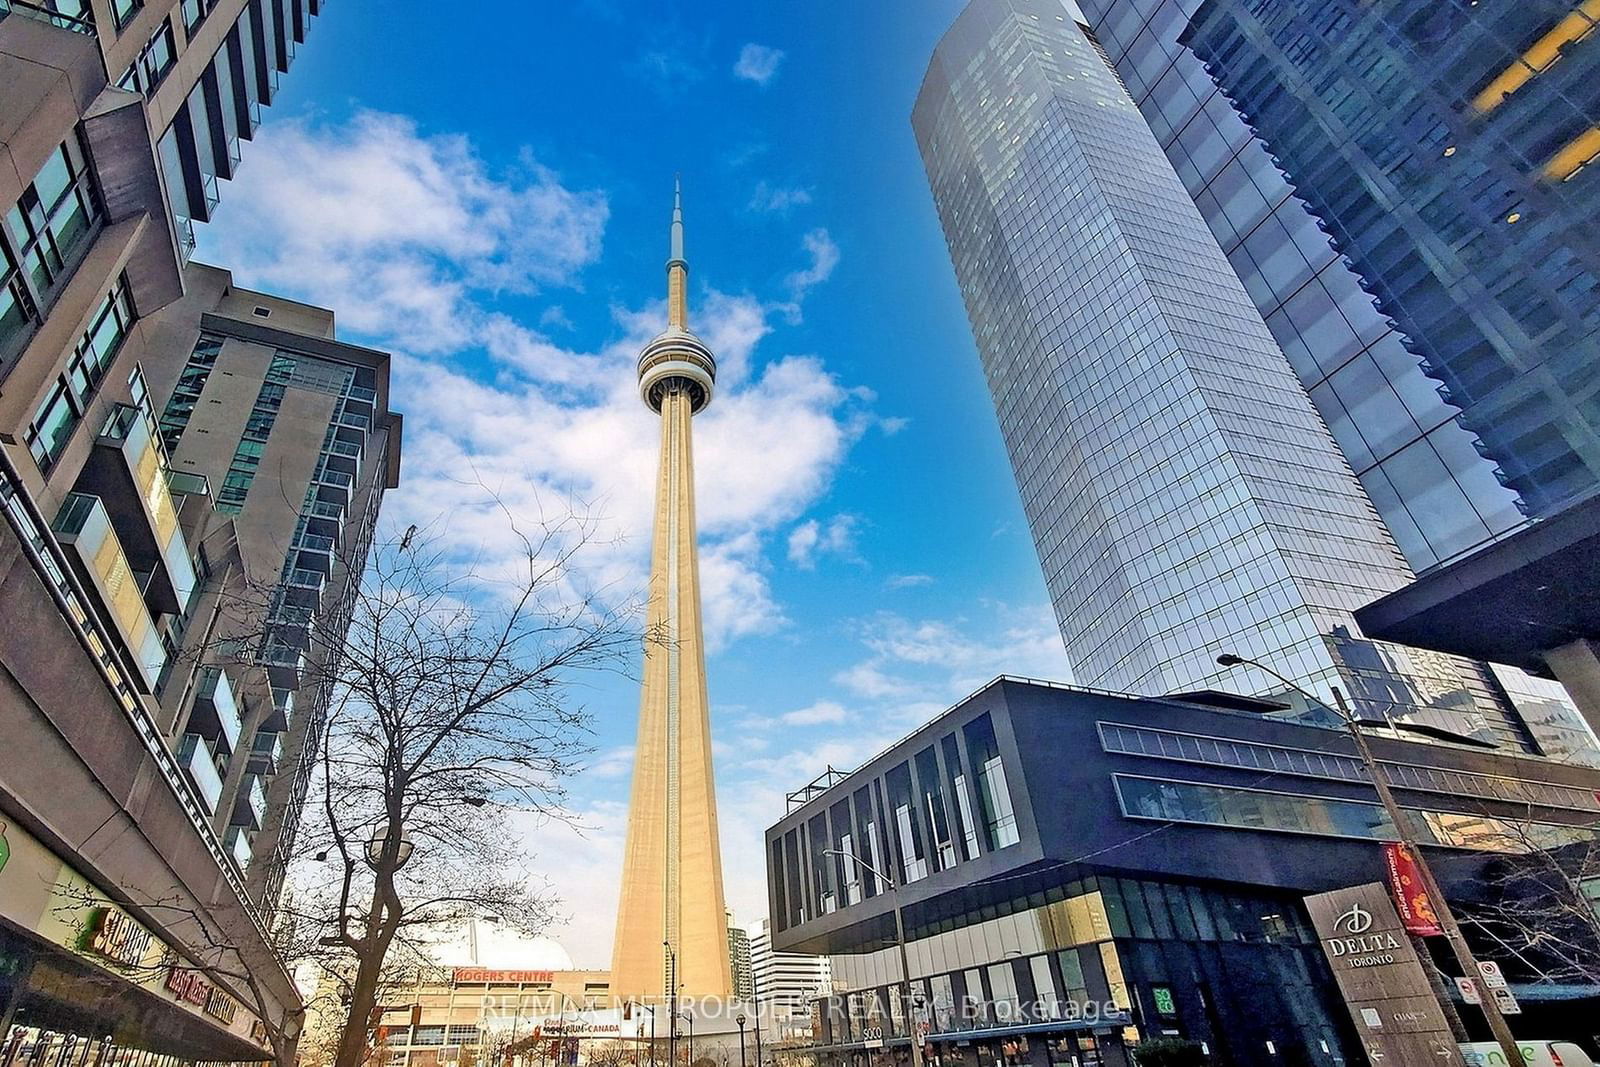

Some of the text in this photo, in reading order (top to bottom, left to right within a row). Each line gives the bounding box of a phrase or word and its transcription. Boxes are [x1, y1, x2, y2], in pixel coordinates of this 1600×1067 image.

[1387, 848, 1411, 919] entertainment
[1327, 933, 1401, 956] DELTA
[1347, 954, 1394, 968] TORONTO
[455, 970, 554, 982] ROGERS CENTRE
[587, 1025, 620, 1033] CANADA
[863, 1026, 882, 1041] SOCO
